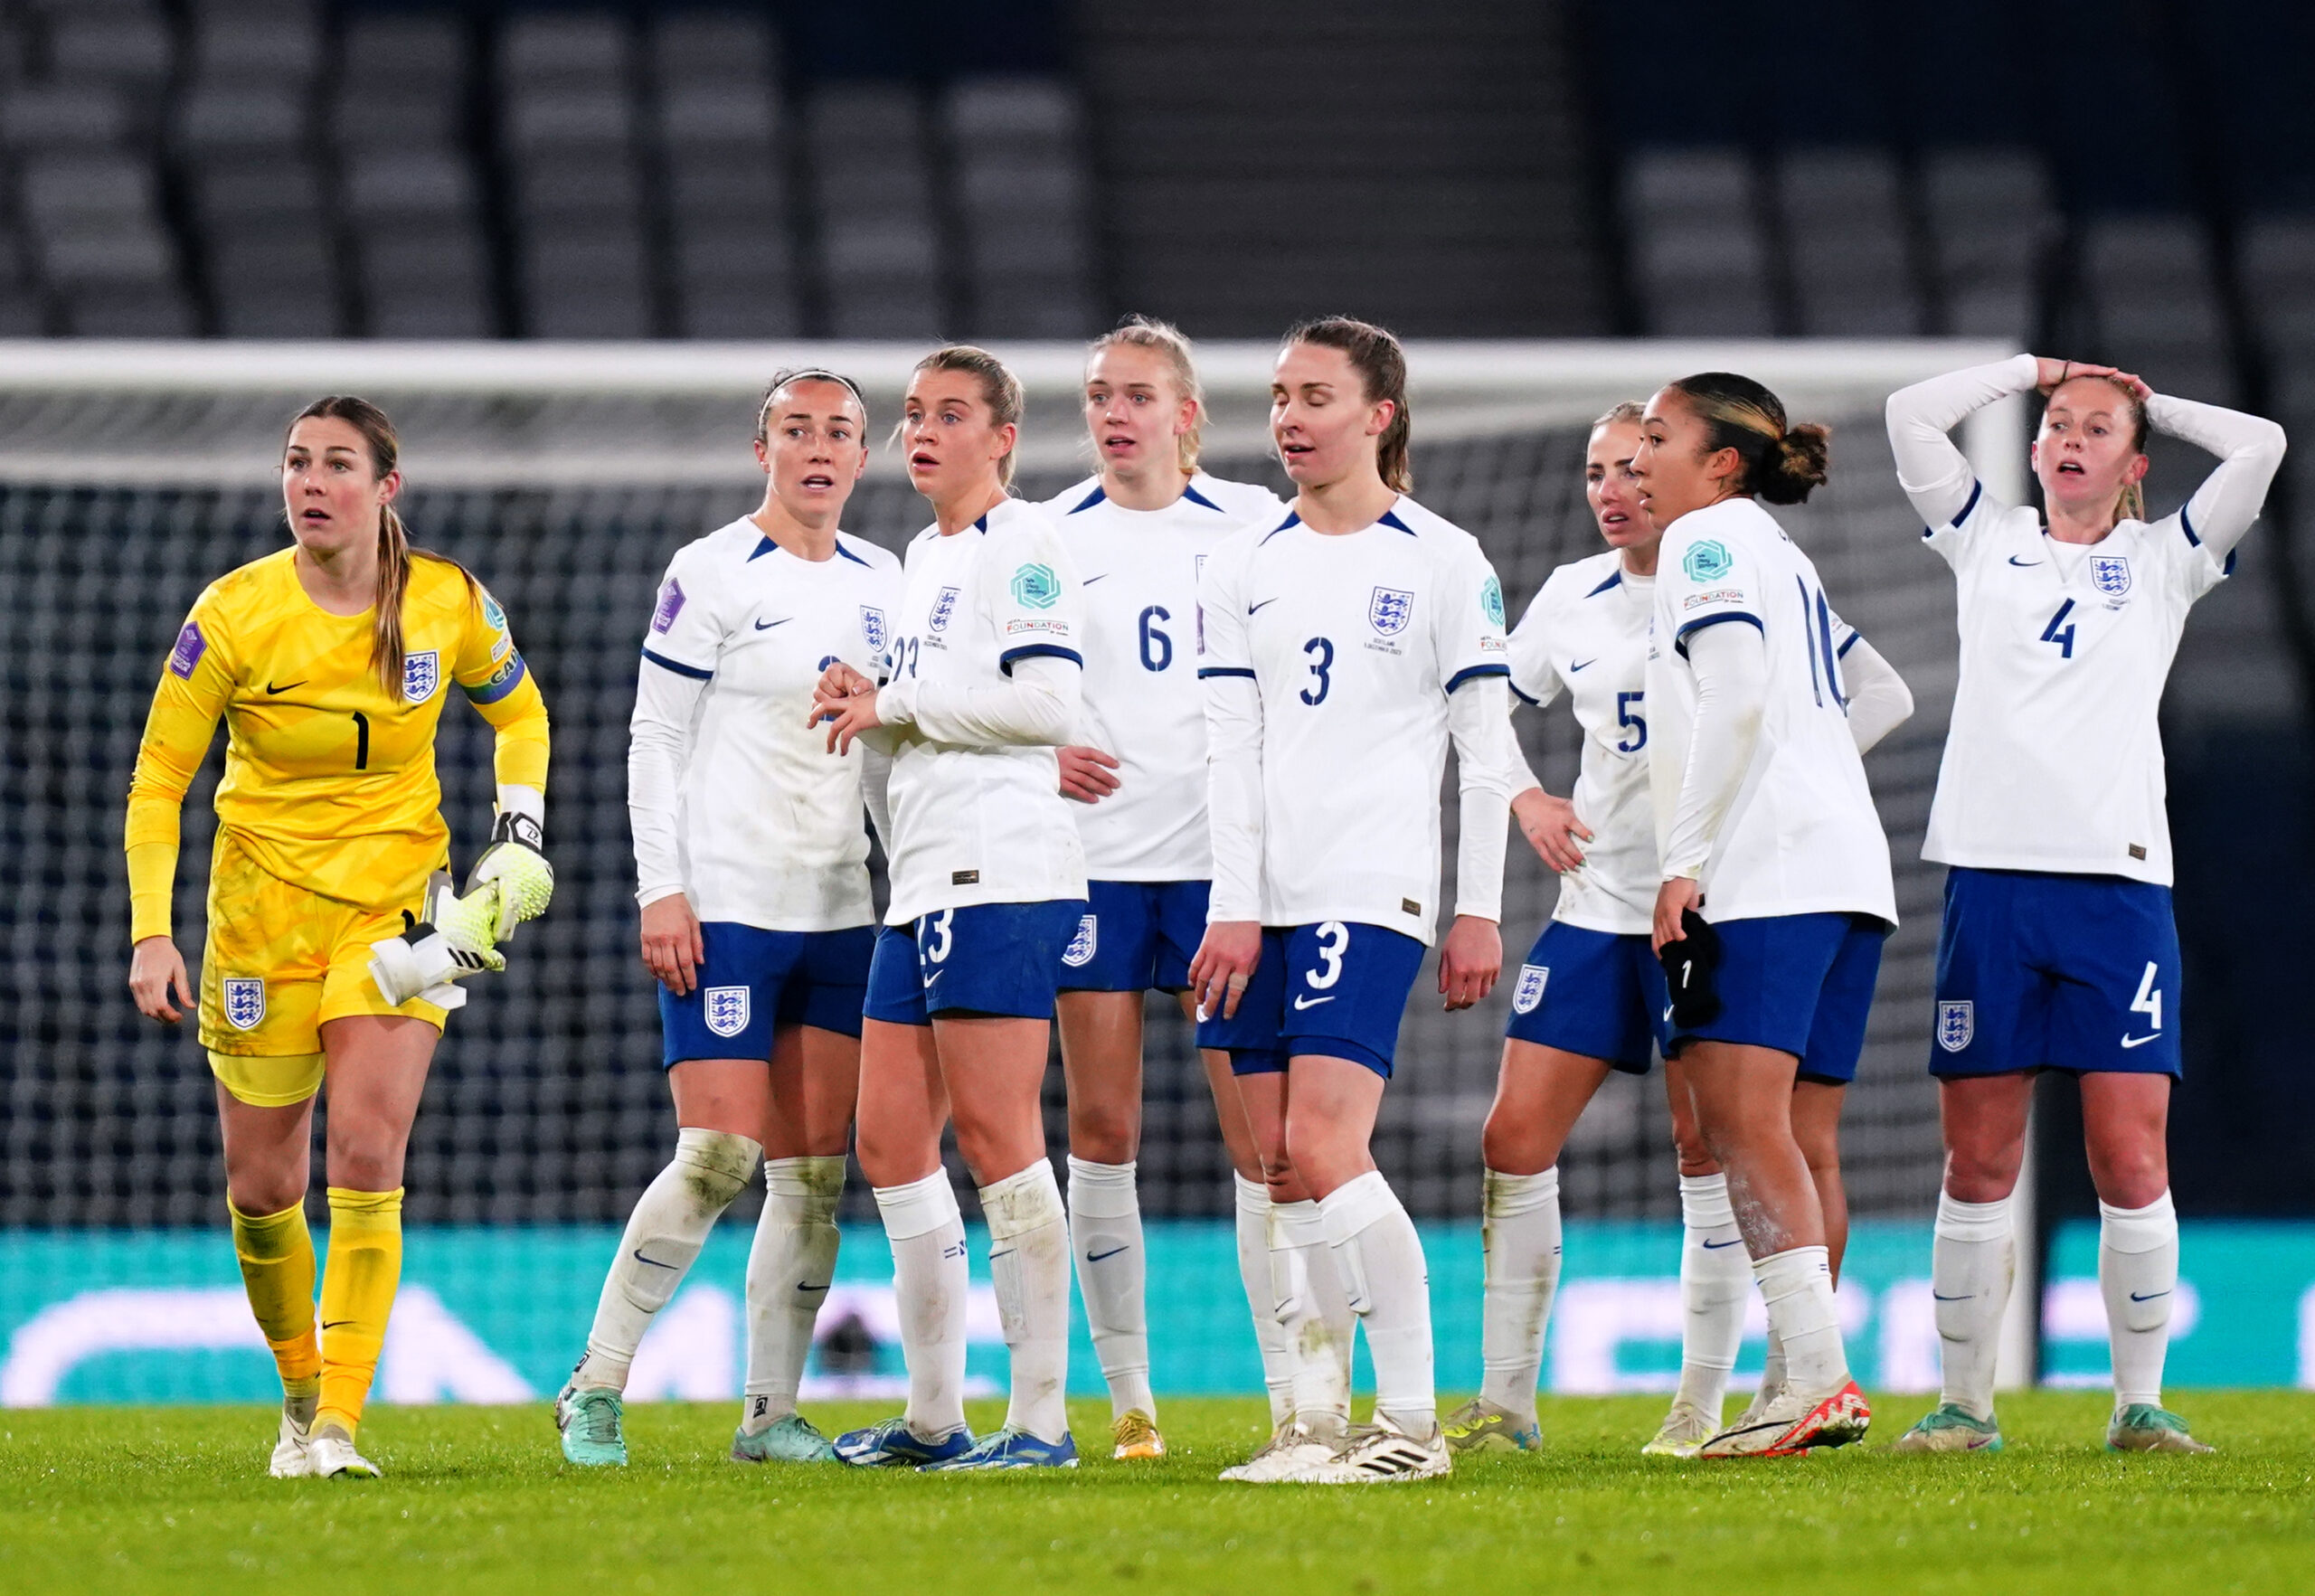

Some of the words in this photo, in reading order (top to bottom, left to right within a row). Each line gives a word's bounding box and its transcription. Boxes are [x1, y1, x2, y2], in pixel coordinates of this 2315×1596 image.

[1006, 621, 1070, 632] FOUNDATION
[1684, 590, 1744, 609] FOUNDATION
[2039, 597, 2076, 659] 4
[1139, 604, 1173, 673] 6
[1299, 637, 1334, 706] 3
[352, 711, 370, 770] 1
[1617, 691, 1649, 753] 5
[1306, 920, 1350, 990] 3
[1682, 959, 1692, 989] 1
[2130, 960, 2162, 1030] 4
